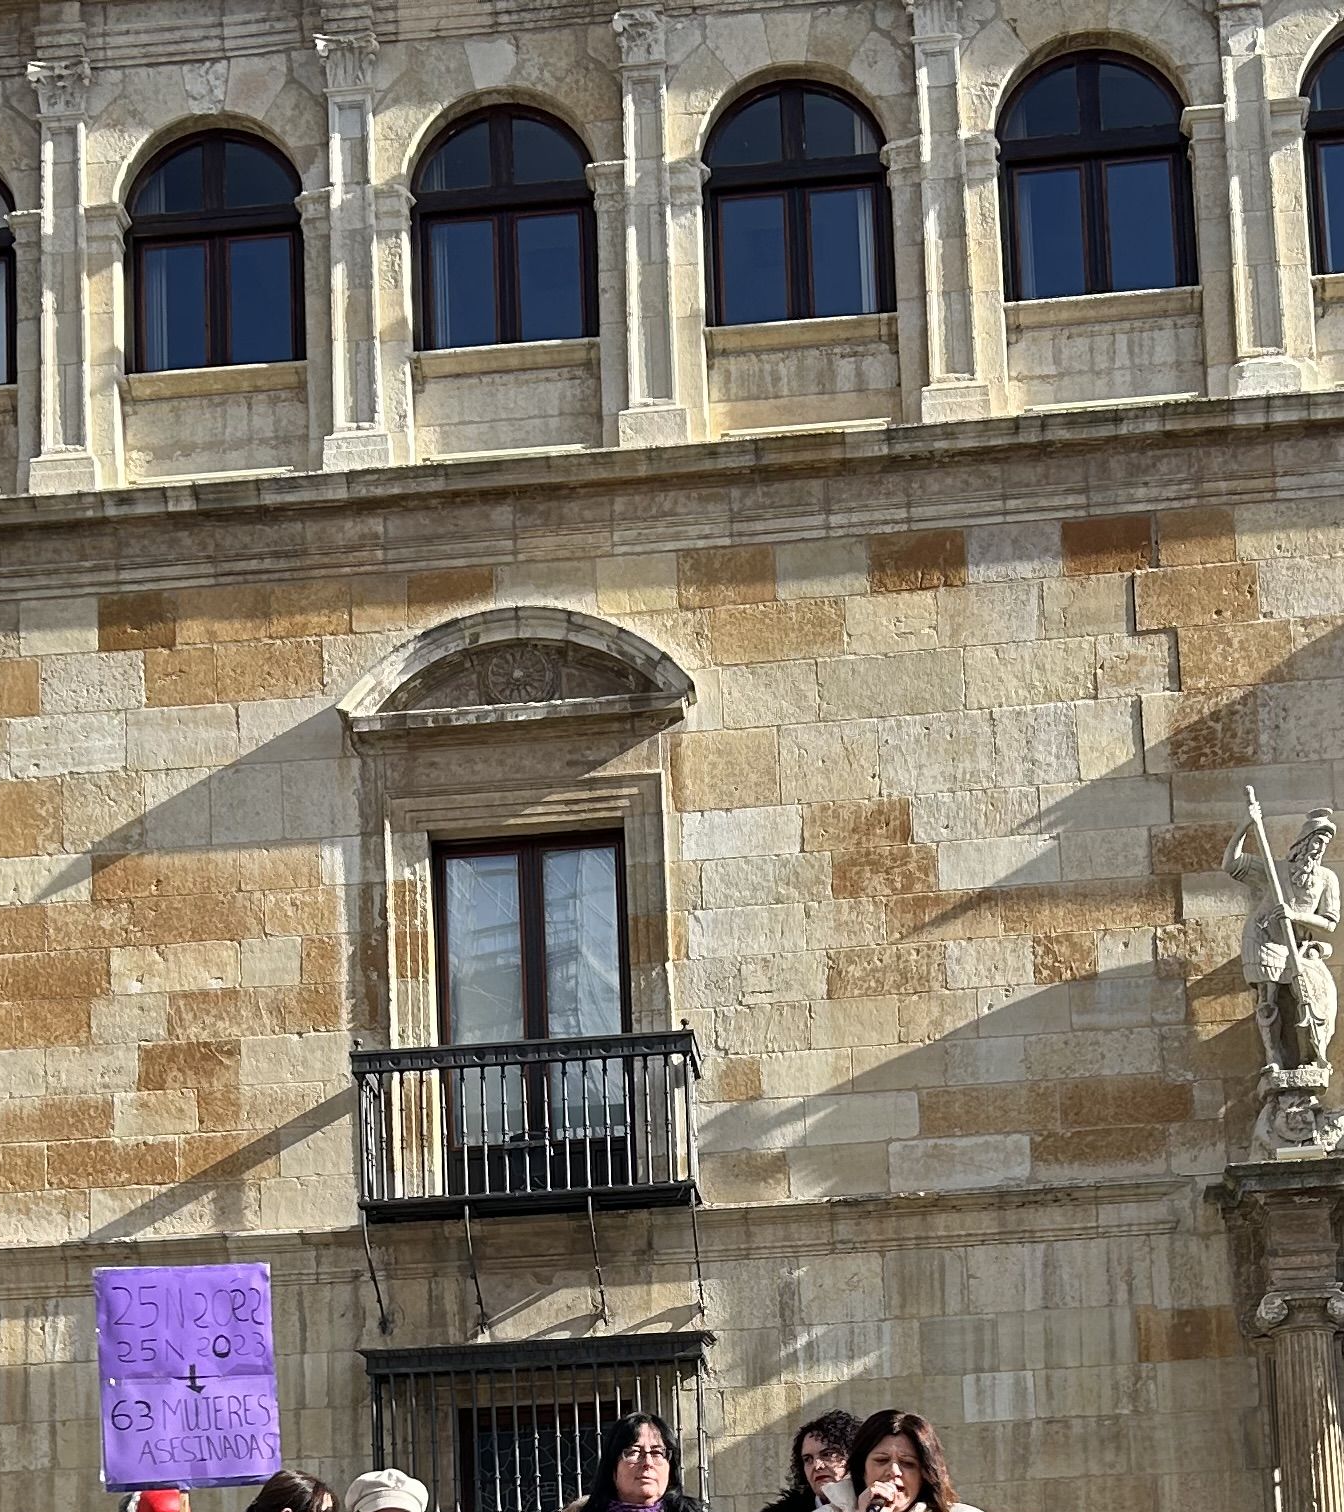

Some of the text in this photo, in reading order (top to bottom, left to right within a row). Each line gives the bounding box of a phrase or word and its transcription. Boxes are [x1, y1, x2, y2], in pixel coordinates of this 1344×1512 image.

[111, 1394, 272, 1432] 63 MUJERES
[139, 1433, 279, 1465] ASESINADAS
